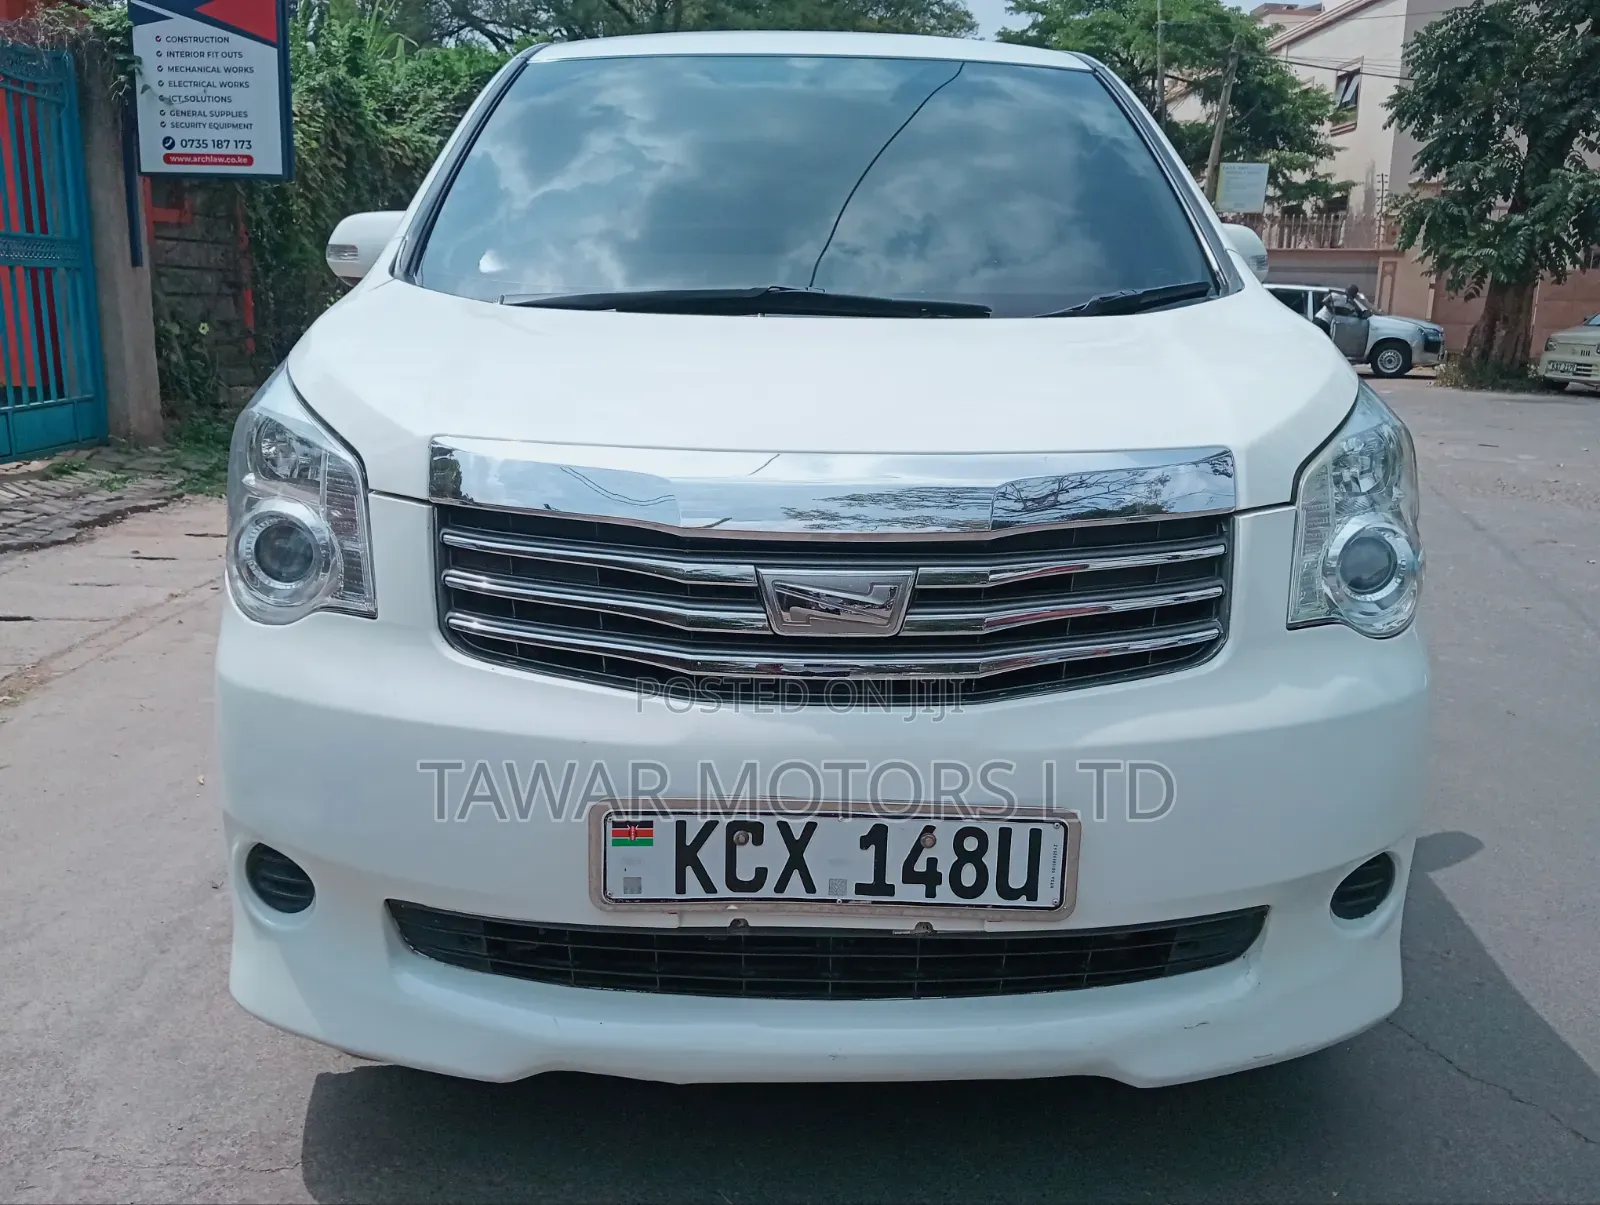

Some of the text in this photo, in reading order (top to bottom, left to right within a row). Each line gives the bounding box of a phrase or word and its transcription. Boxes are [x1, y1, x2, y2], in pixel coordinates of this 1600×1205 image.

[165, 35, 230, 44] CONSTRUCTION
[221, 51, 243, 59] OUTS
[223, 66, 254, 74] WORKS
[168, 80, 217, 88] ELECTRICAL
[169, 95, 232, 103] ICT SOLUTIONS
[169, 109, 248, 118] GENERAL SUPPLIES
[208, 122, 253, 130] EQUIPMENT
[180, 139, 252, 150] 0735 187 173
[169, 155, 248, 164] www.archlaw.co.ke
[674, 819, 818, 895] KCX
[854, 823, 1042, 902] 148U
